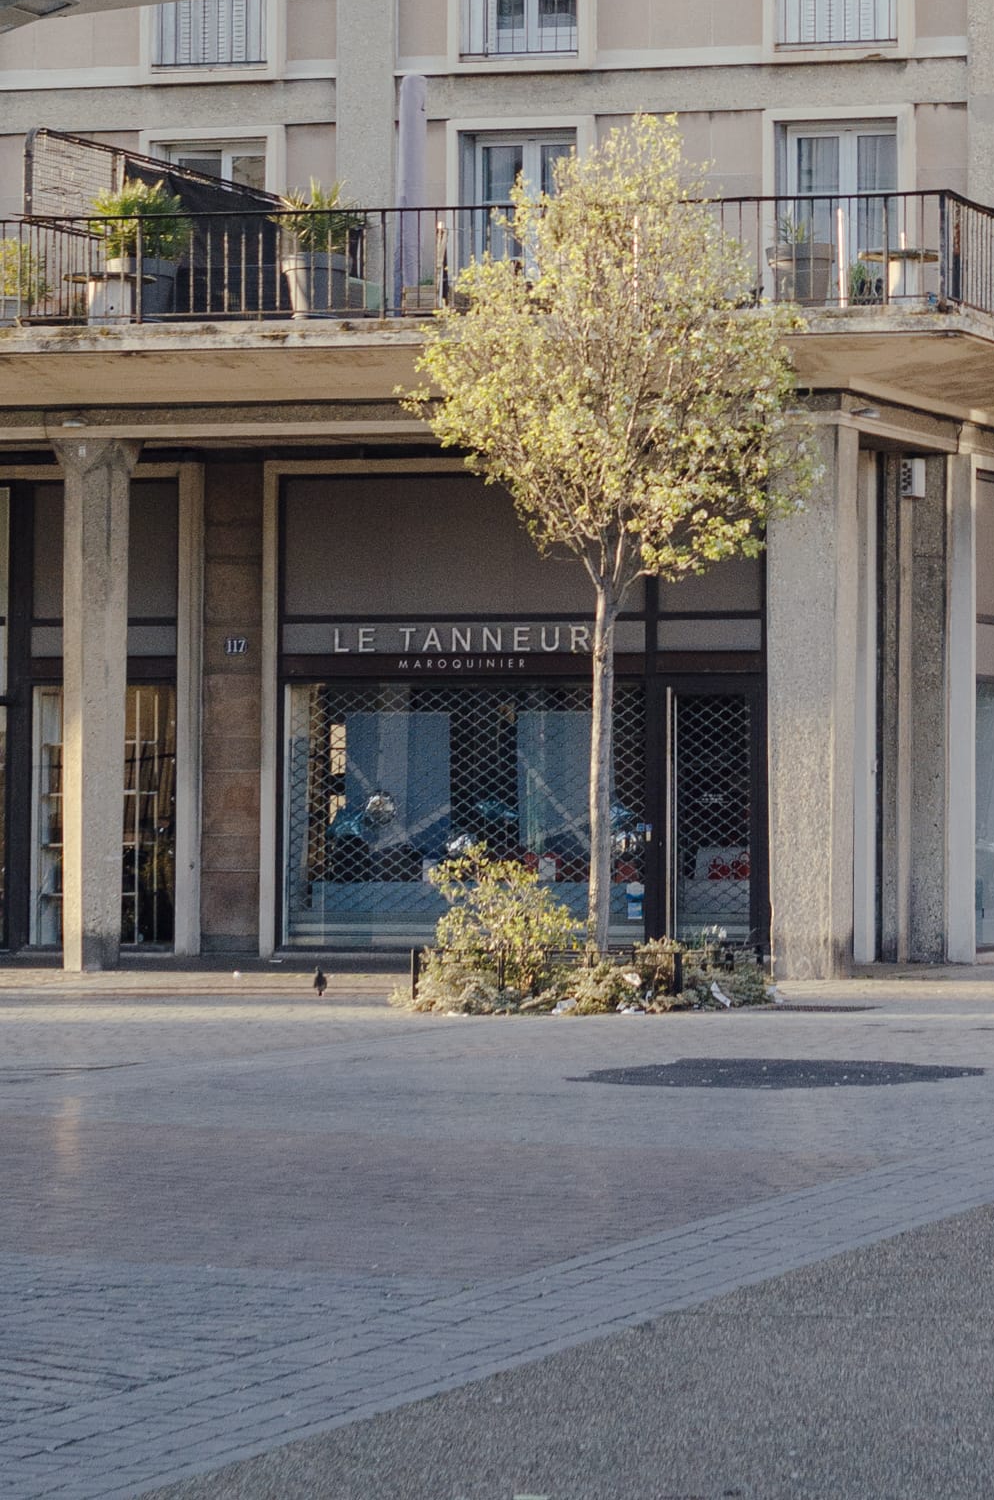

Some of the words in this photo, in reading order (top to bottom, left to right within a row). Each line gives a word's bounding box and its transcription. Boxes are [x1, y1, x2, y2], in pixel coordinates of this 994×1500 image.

[227, 639, 246, 653] 117
[334, 627, 376, 653] LE
[399, 626, 591, 653] TANNEUR
[398, 659, 526, 669] MAROQUINIER
